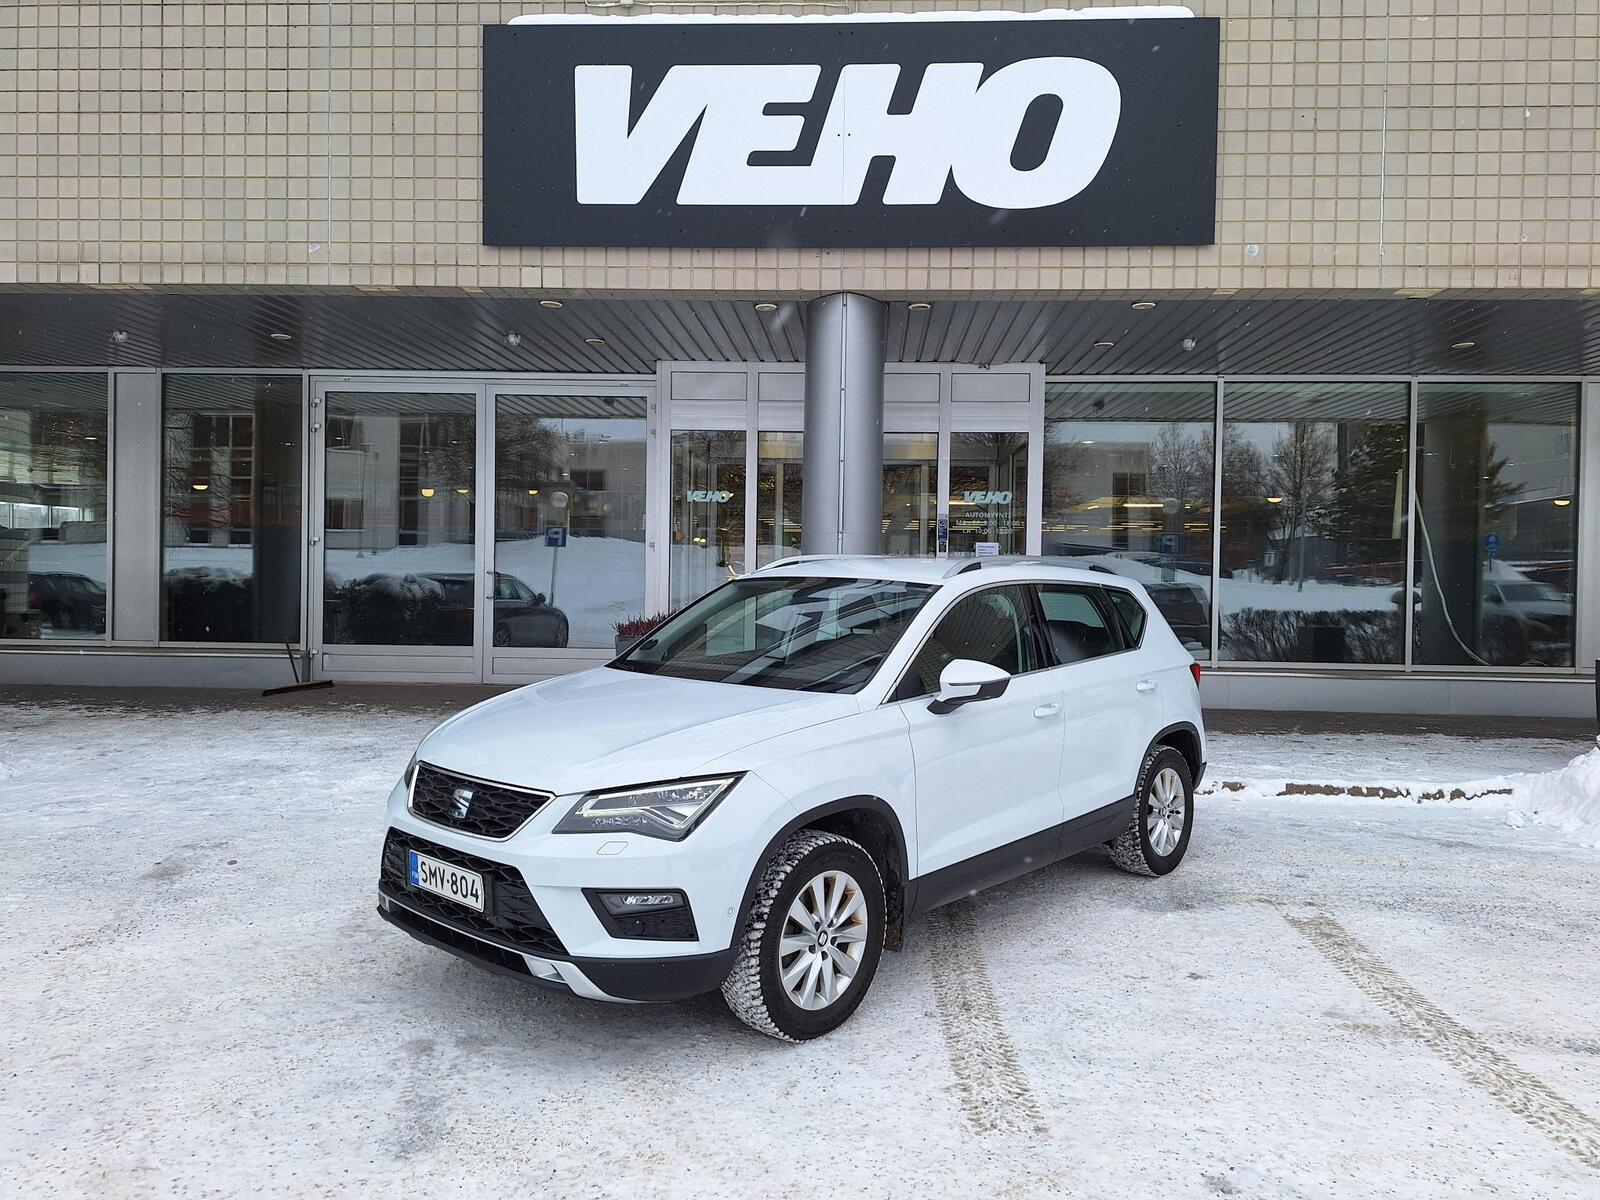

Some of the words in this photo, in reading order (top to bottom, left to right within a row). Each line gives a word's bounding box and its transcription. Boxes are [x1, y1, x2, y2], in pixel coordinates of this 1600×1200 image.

[574, 56, 1122, 209] VEHO
[687, 490, 731, 503] VEHO
[964, 490, 1012, 504] VEHO
[420, 861, 479, 903] SMV-804
